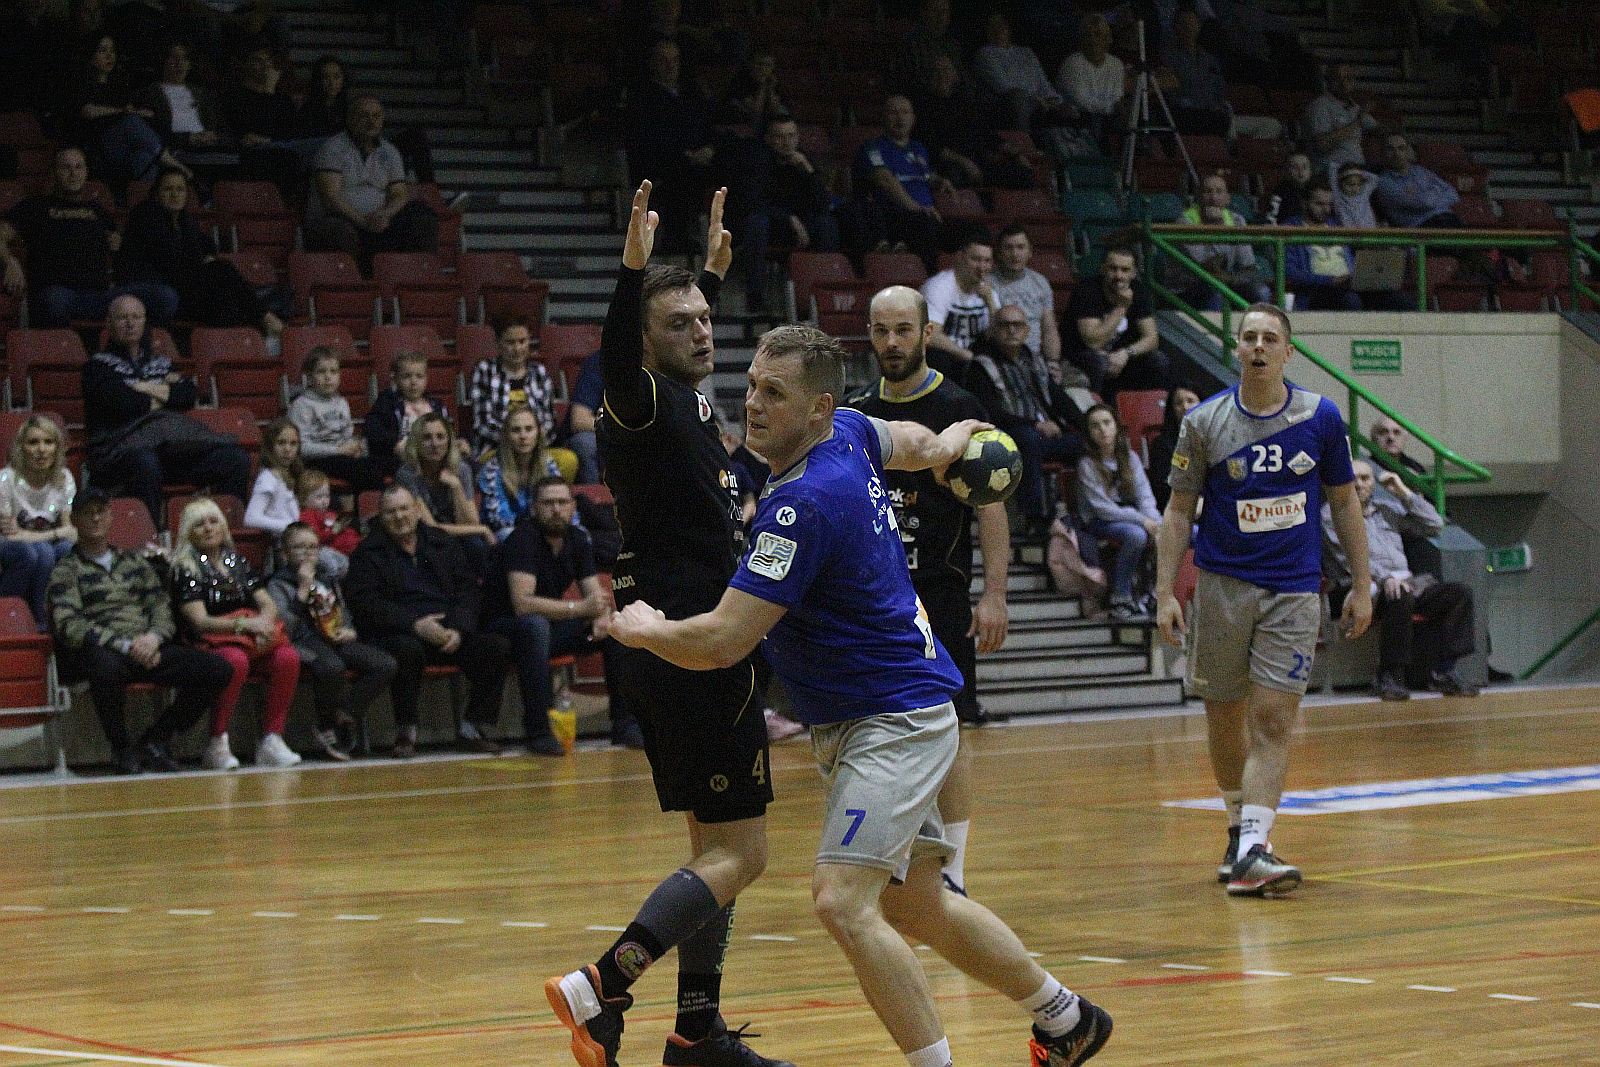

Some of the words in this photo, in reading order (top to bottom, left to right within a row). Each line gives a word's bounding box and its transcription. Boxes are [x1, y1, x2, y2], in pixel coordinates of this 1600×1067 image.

[1251, 444, 1283, 473] 23
[751, 749, 767, 785] 4
[841, 809, 867, 847] 7
